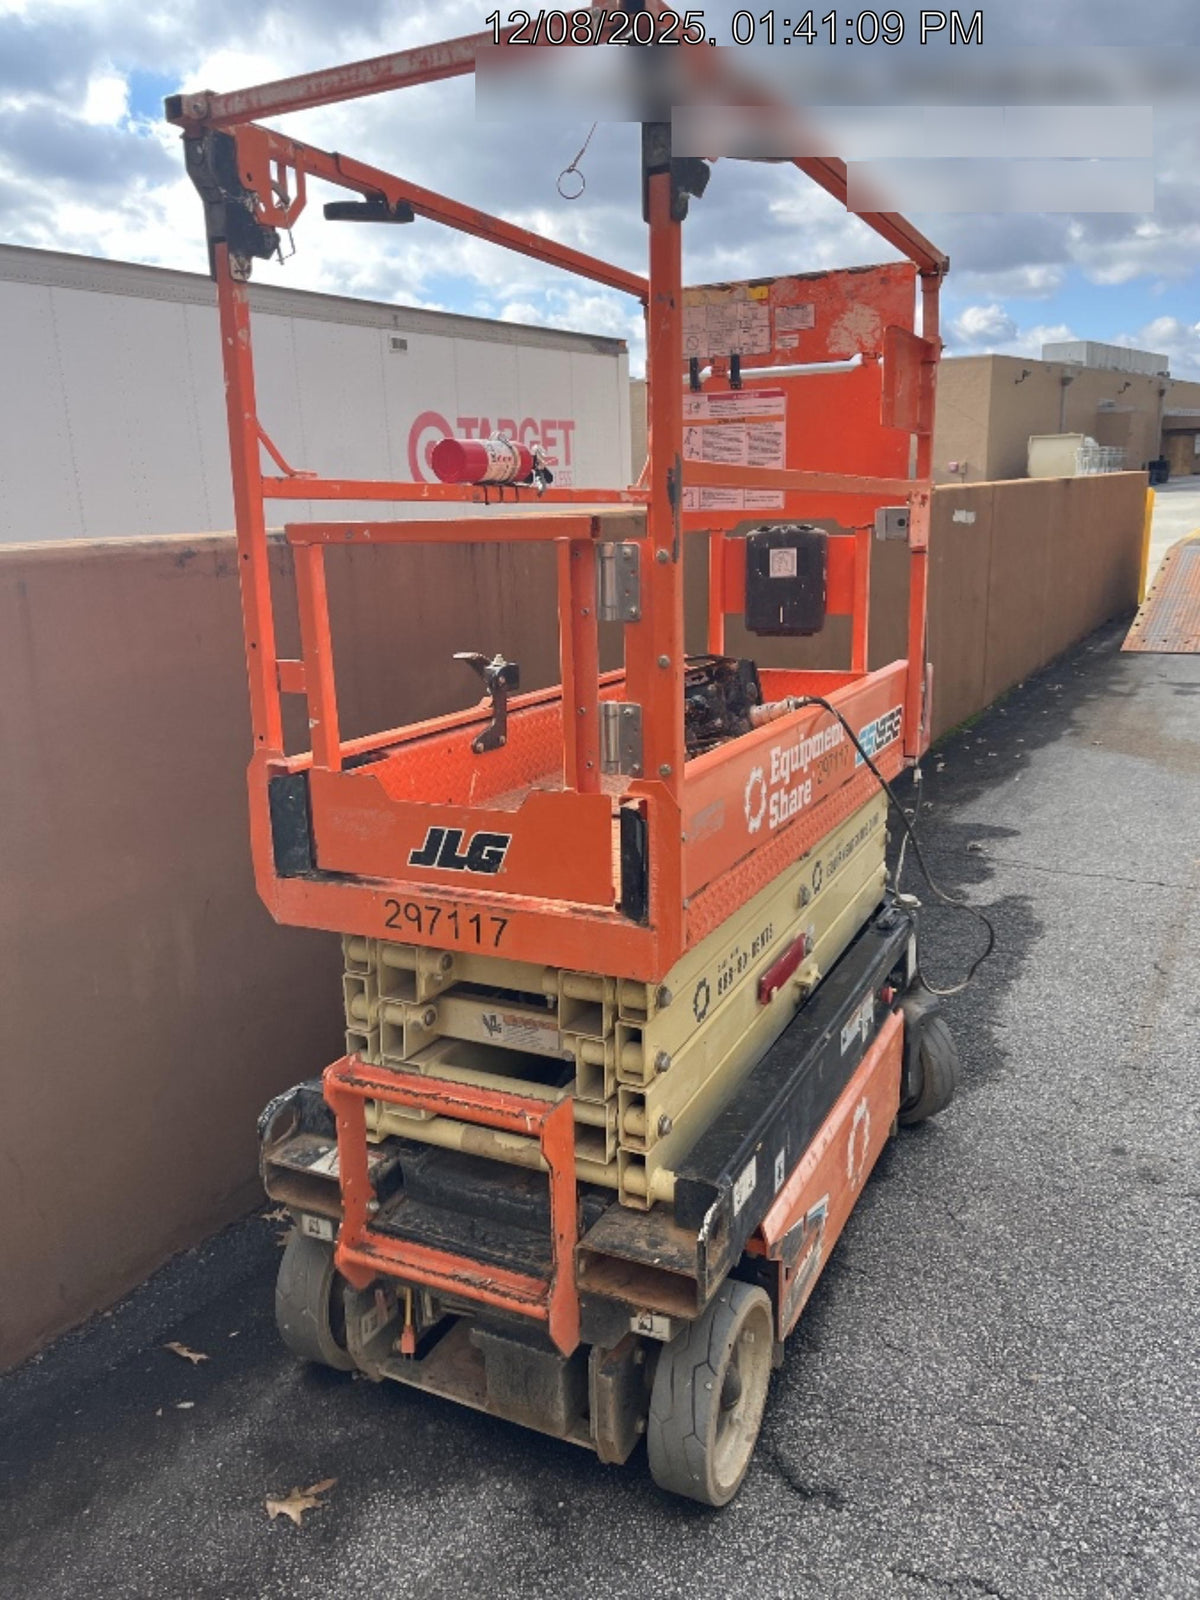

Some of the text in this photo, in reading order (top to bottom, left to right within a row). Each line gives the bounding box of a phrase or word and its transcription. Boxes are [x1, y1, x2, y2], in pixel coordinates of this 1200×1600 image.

[769, 721, 845, 786] Equipment
[769, 778, 812, 830] Share
[407, 826, 512, 876] JLG
[384, 898, 509, 948] 297117
